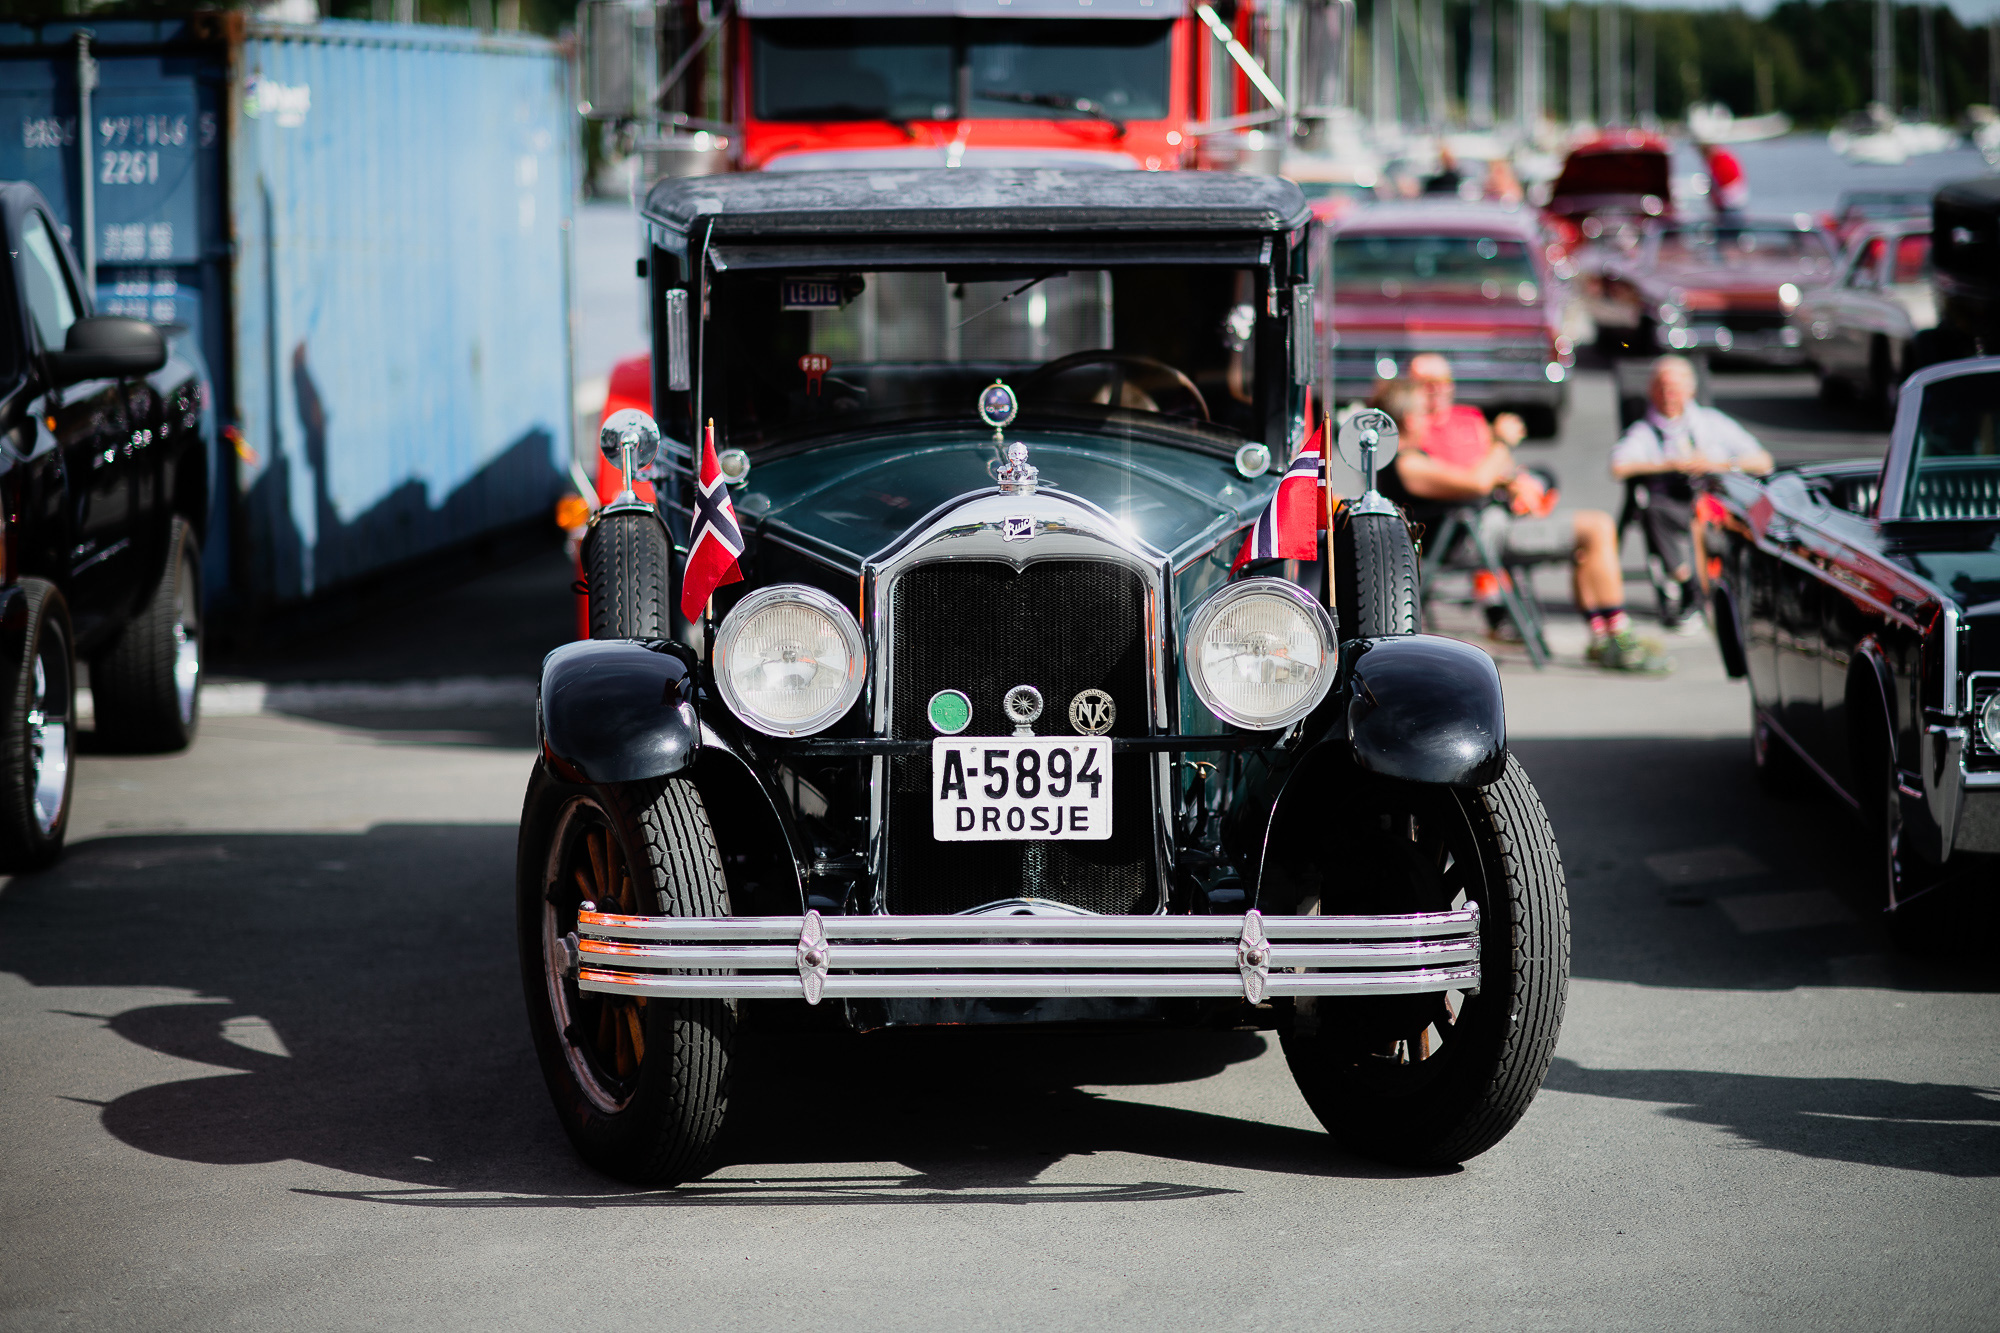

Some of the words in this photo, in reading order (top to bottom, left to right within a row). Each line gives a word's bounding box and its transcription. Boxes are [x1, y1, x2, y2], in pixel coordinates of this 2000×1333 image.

[101, 150, 159, 184] 2261
[790, 283, 836, 303] LEDIG
[801, 357, 827, 371] FRI
[940, 747, 1103, 800] A-5894
[956, 806, 1089, 836] DROSJE
